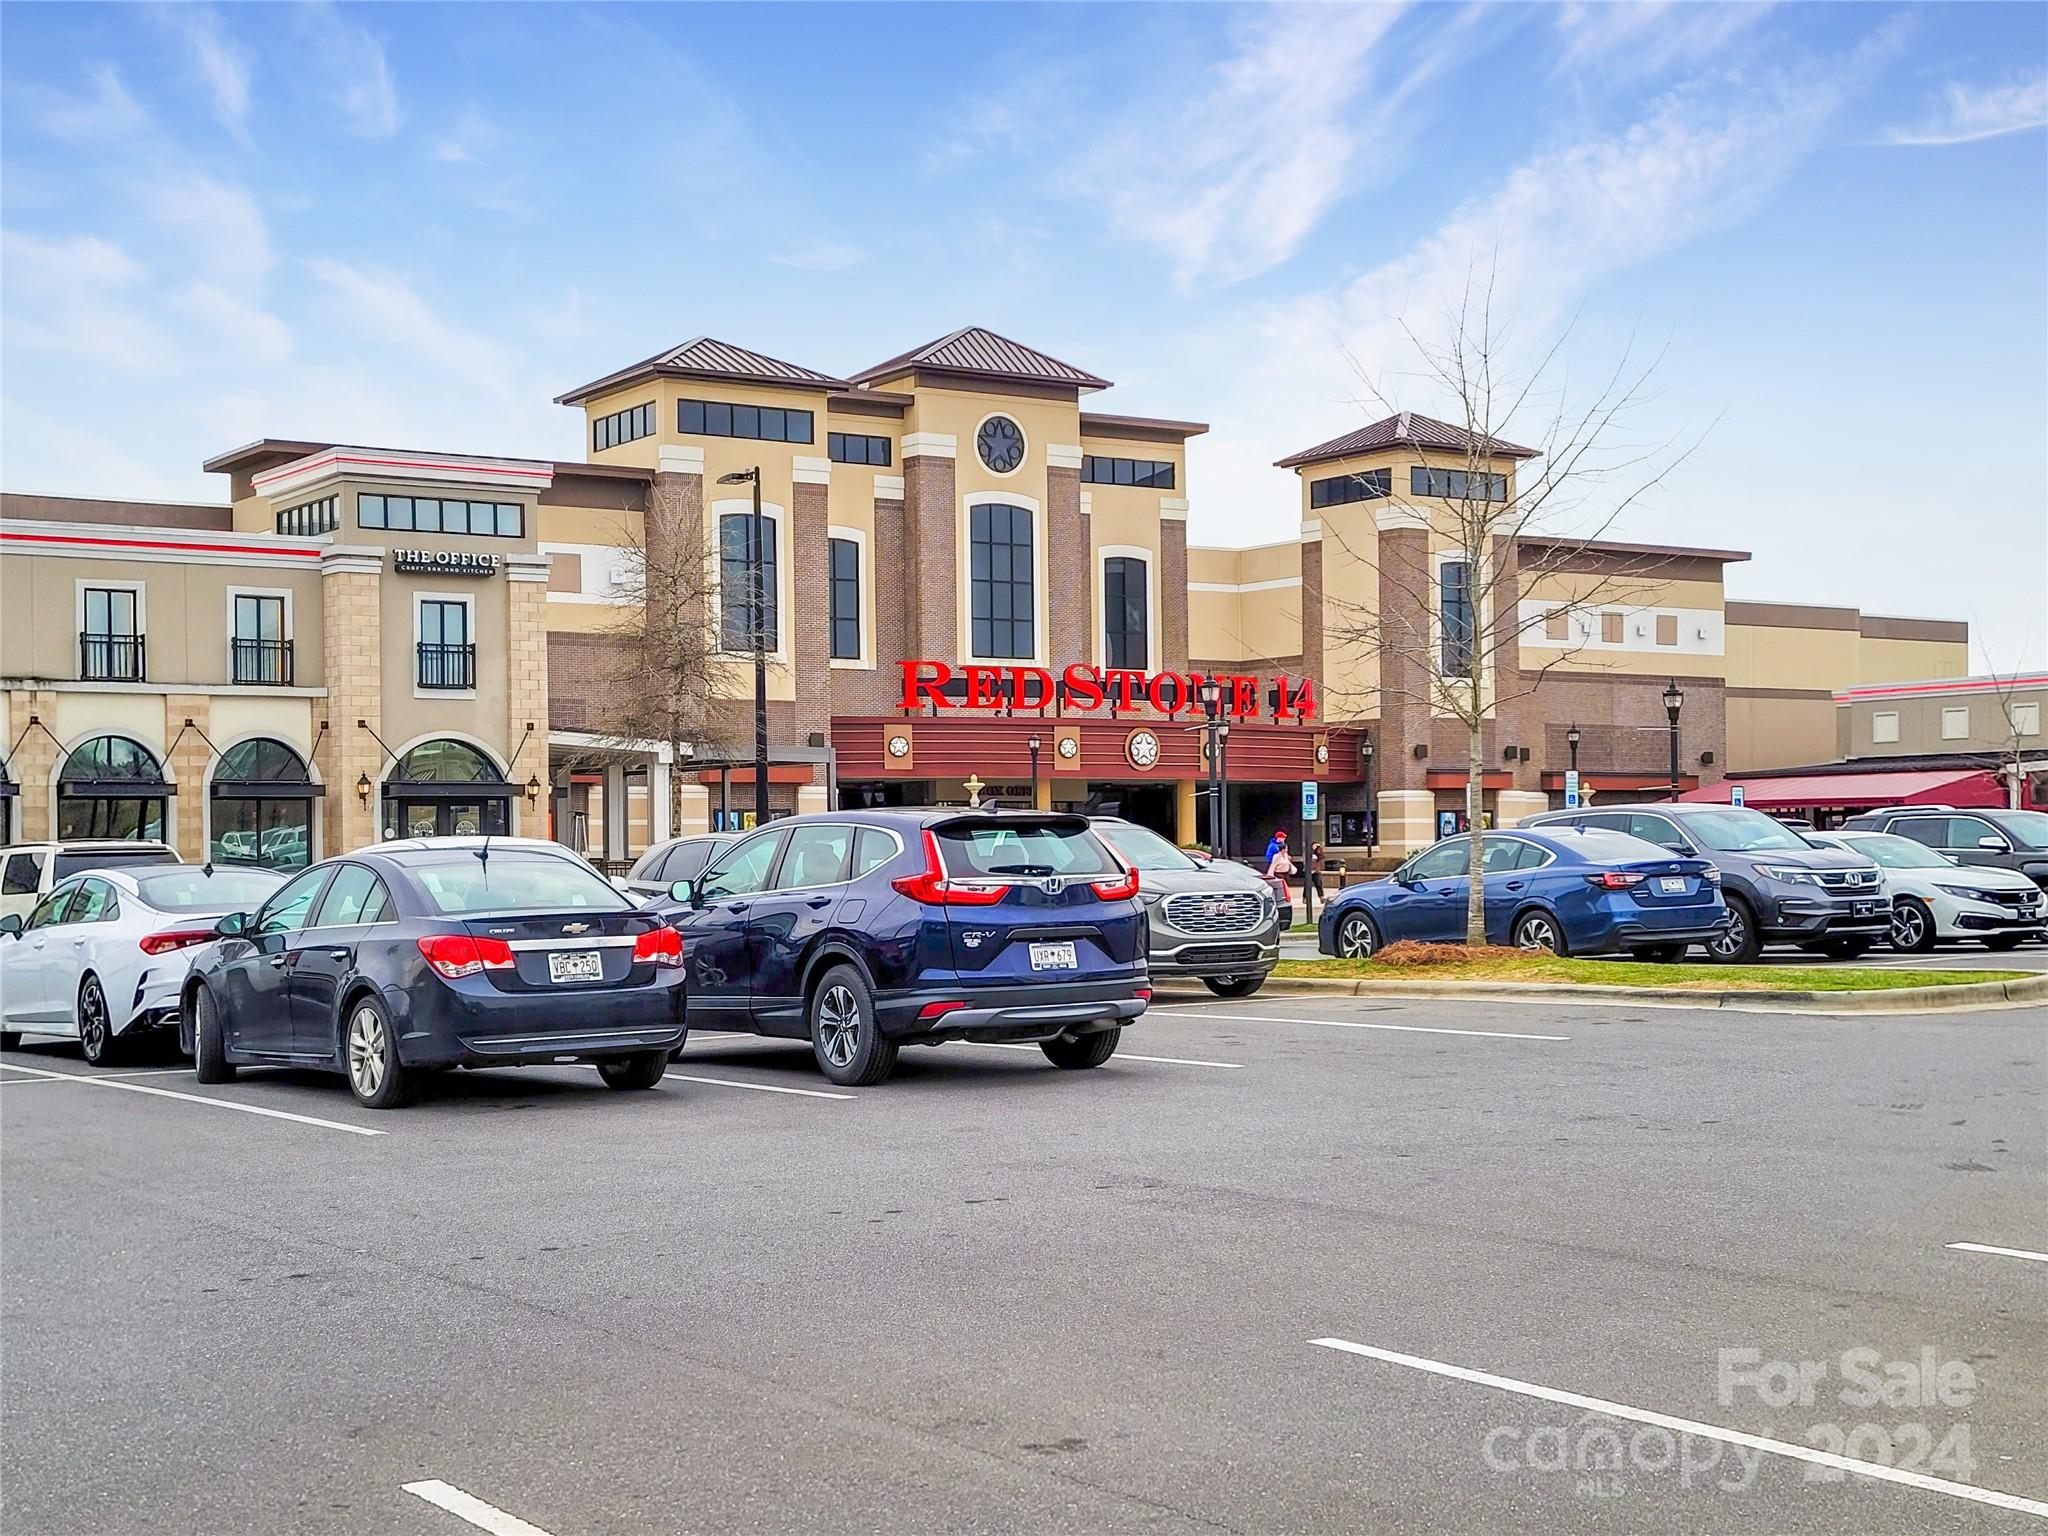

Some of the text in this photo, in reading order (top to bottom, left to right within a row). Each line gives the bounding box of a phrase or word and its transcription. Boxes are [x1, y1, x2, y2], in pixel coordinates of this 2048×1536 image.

[394, 549, 500, 567] THE OFFICE
[1273, 674, 1318, 720] 14
[1202, 902, 1237, 915] GMC
[962, 931, 996, 939] CR-V
[1033, 949, 1072, 962] UXR 679
[553, 960, 598, 974] VBC 250
